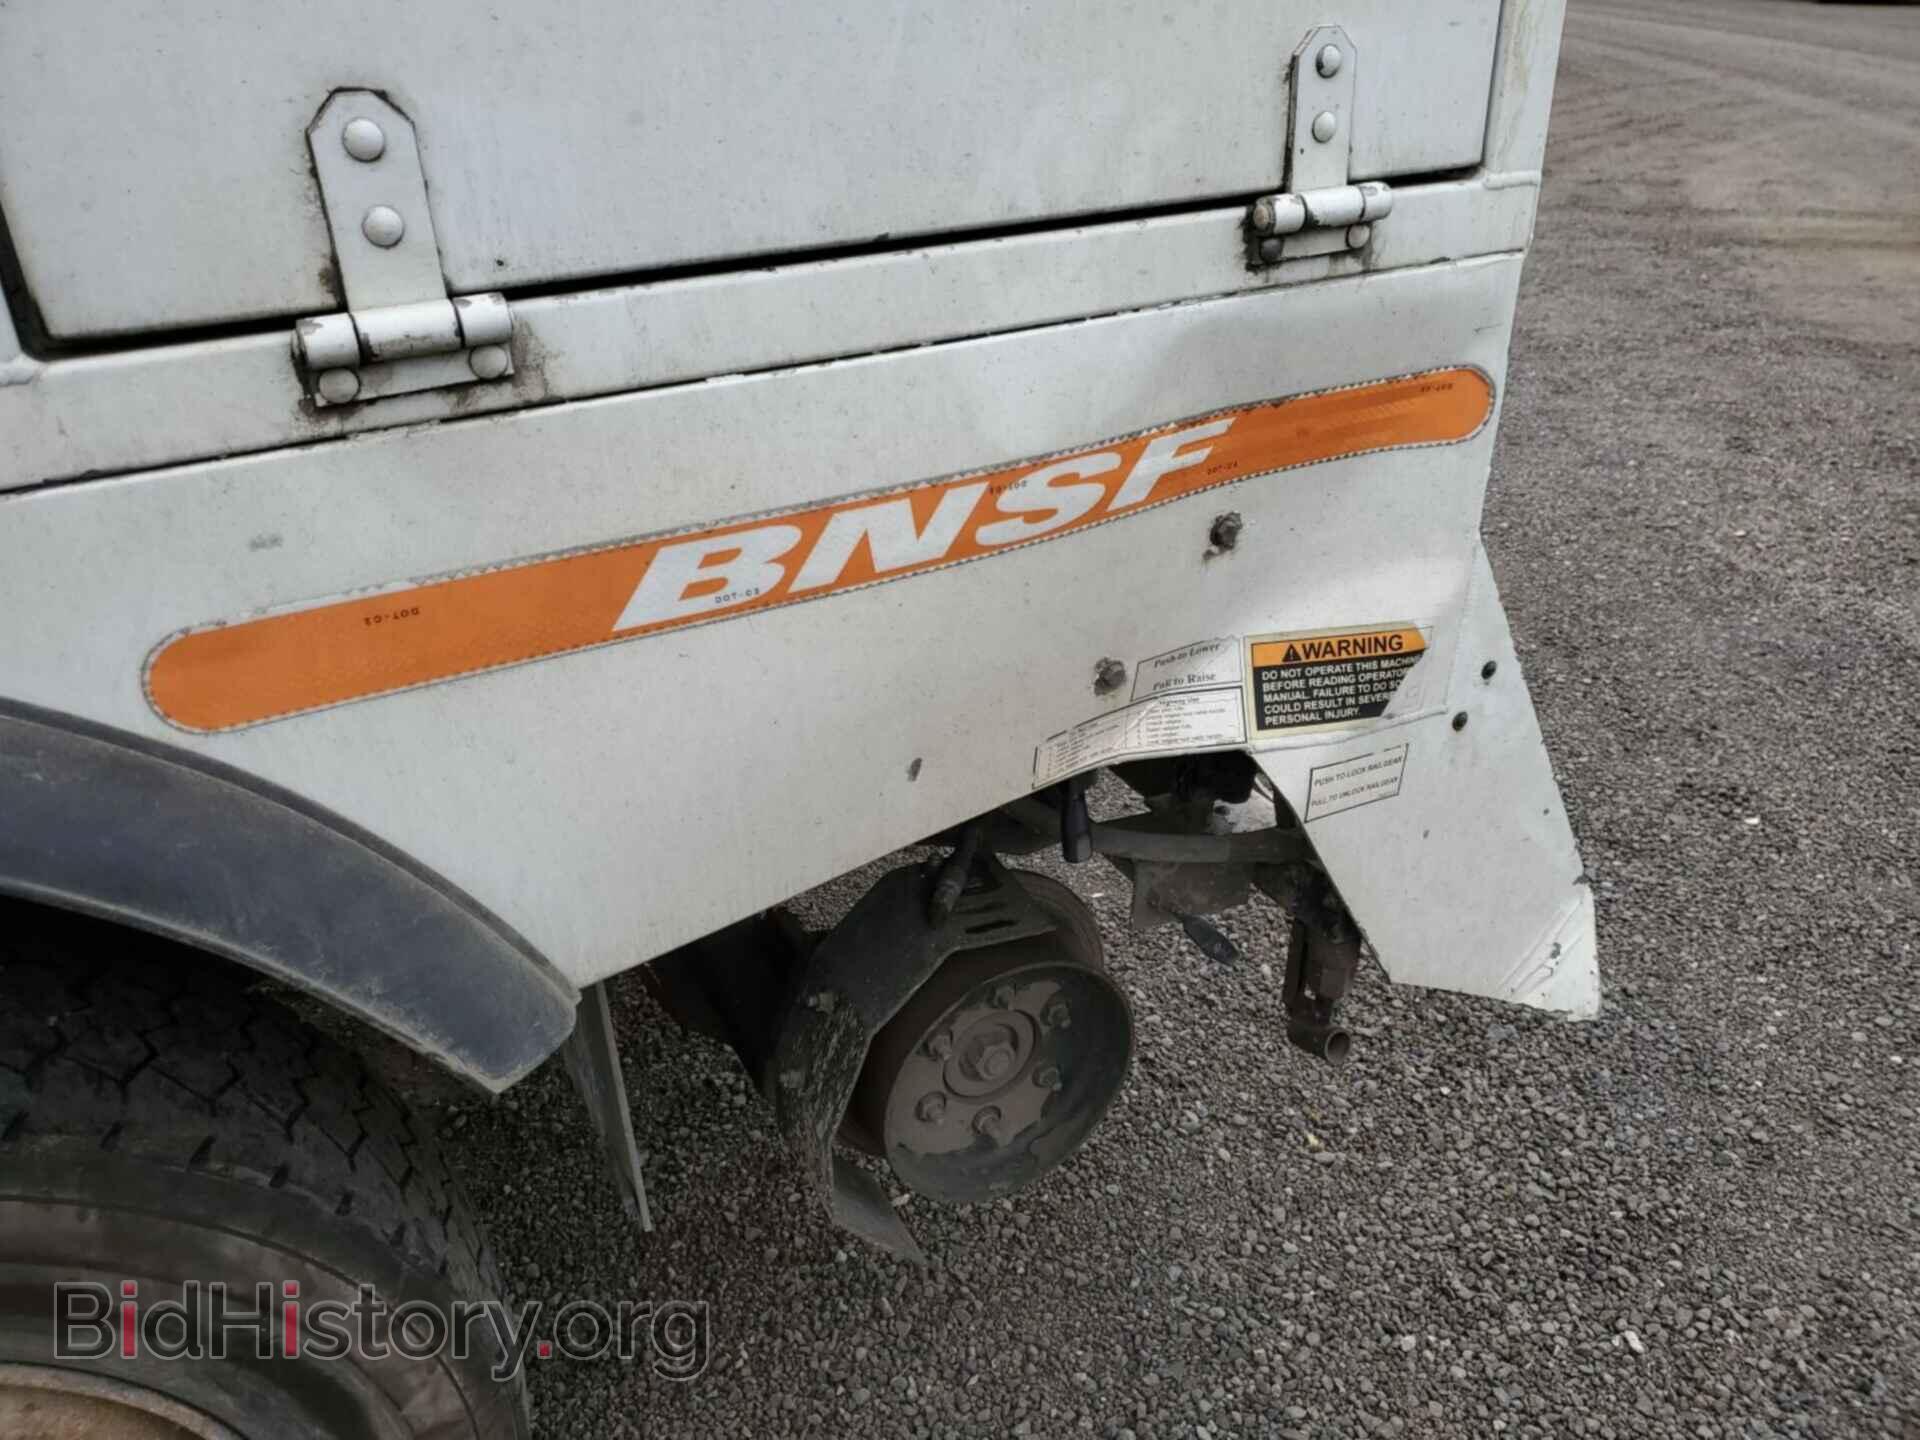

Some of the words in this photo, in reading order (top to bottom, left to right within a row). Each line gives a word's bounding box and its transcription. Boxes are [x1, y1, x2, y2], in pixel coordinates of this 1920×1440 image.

[611, 417, 1237, 631] BNSF
[1301, 634, 1404, 660] WARNING
[1262, 670, 1278, 681] DO
[1280, 668, 1302, 679] NOT
[1305, 663, 1354, 677] OPERATE
[1356, 659, 1378, 672] THIS
[1262, 679, 1307, 693] BEFORE
[1308, 674, 1356, 688] READING
[1313, 685, 1356, 699] FAILURE
[1358, 684, 1371, 694] TO
[1373, 681, 1387, 692] DO
[1264, 702, 1302, 715] COULD
[1303, 697, 1343, 711] RESULT
[1345, 696, 1356, 706] IN
[1265, 712, 1322, 726] PERSONAL
